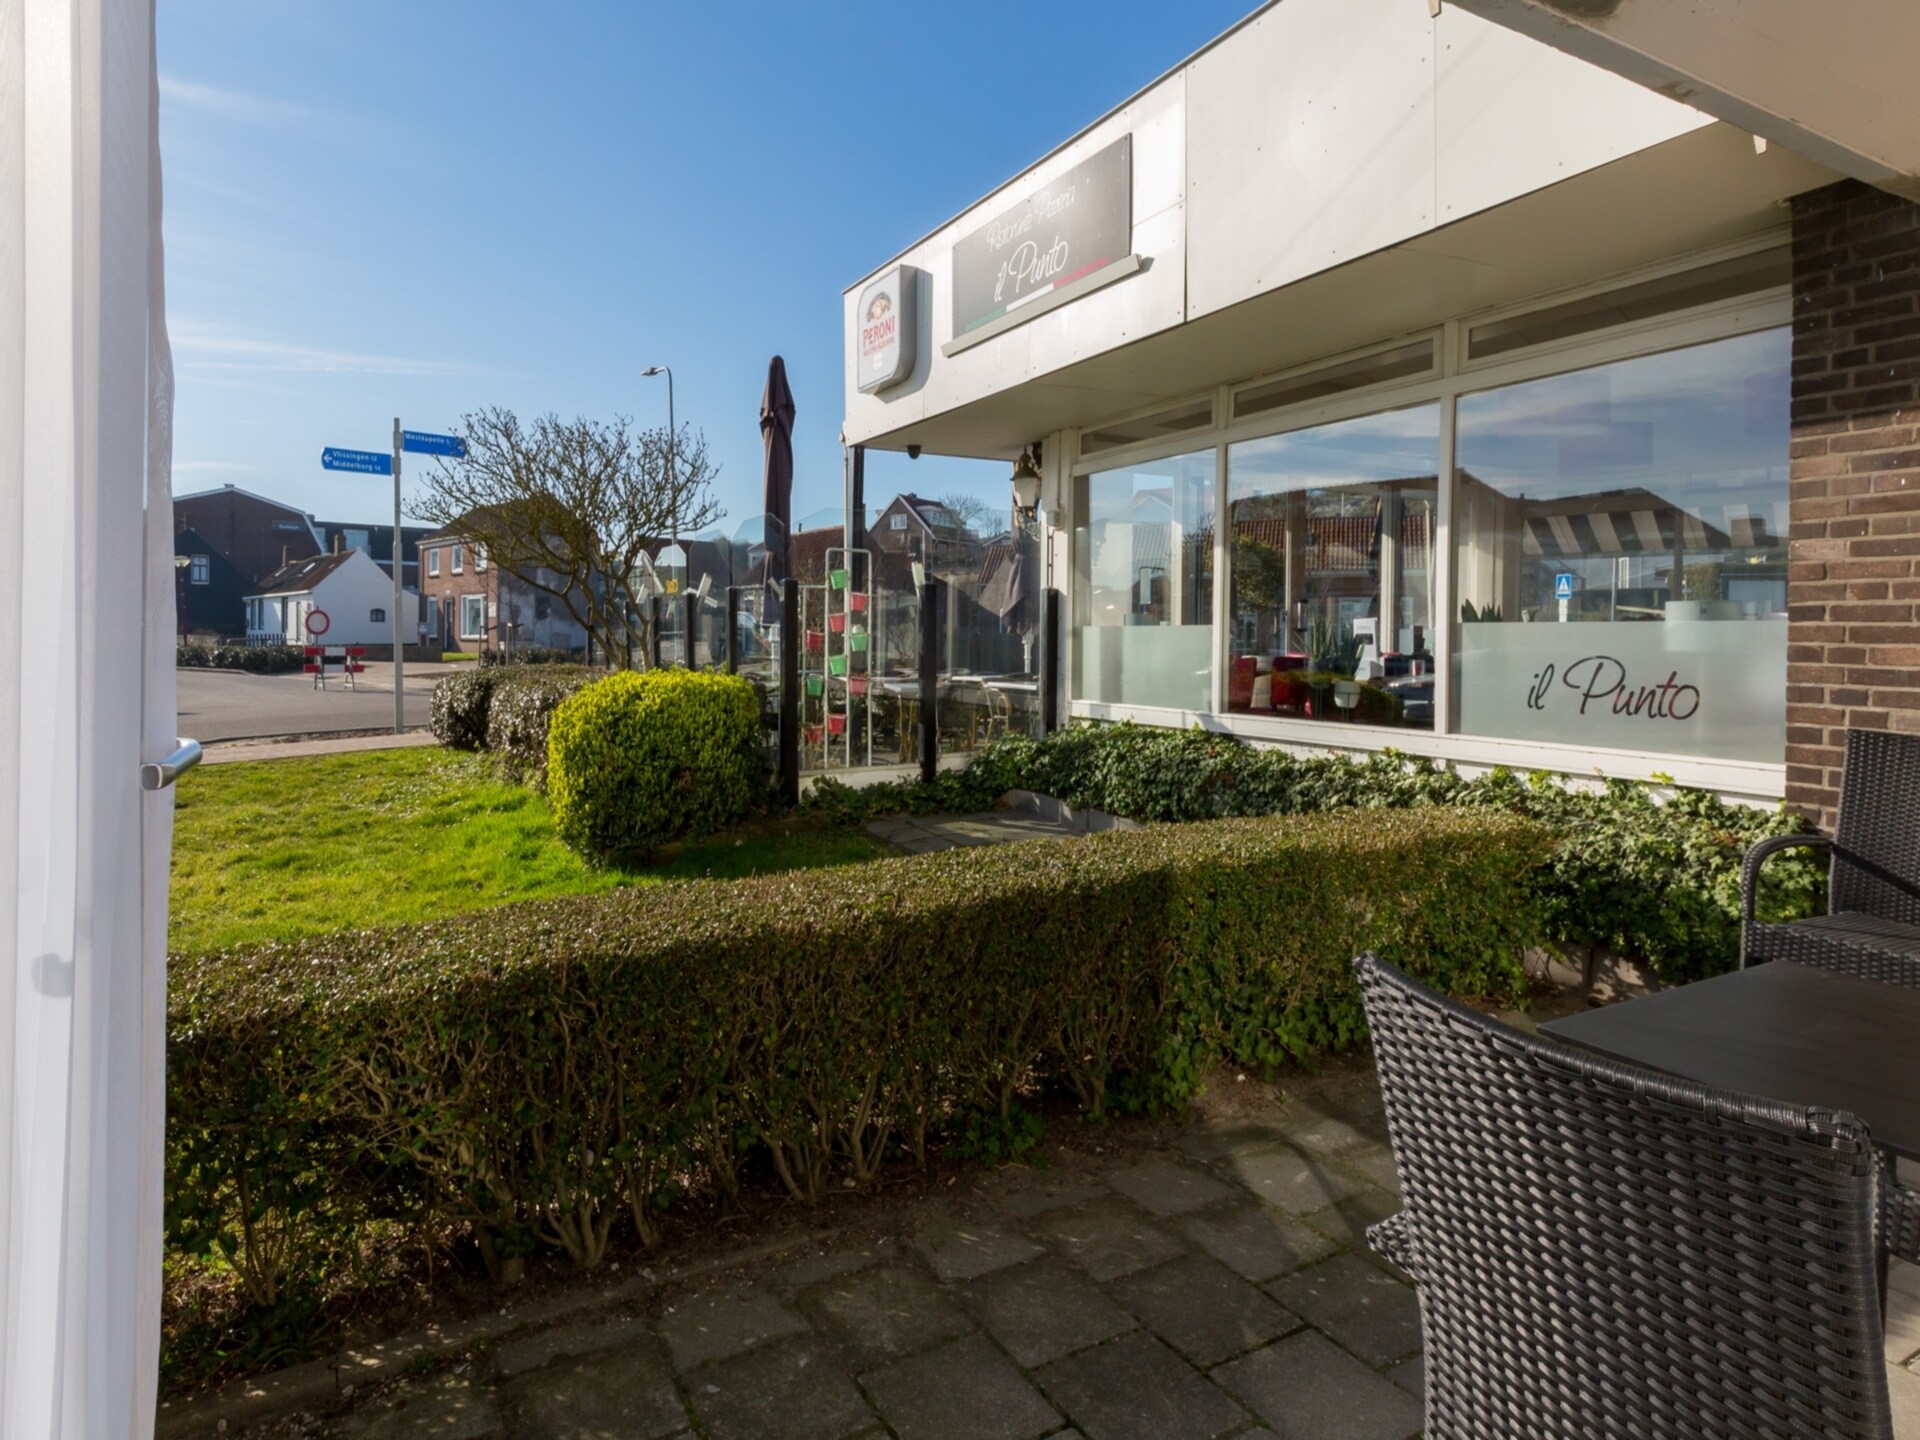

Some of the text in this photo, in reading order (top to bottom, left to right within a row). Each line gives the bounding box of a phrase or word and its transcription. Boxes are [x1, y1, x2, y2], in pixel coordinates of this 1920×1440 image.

[994, 235, 1069, 302] il Punto
[863, 315, 895, 348] PERONI
[405, 433, 445, 445] Westkapelle
[332, 450, 370, 462] Vlissingen
[332, 460, 373, 472] Middelburg
[1527, 655, 1701, 721] il Punto
